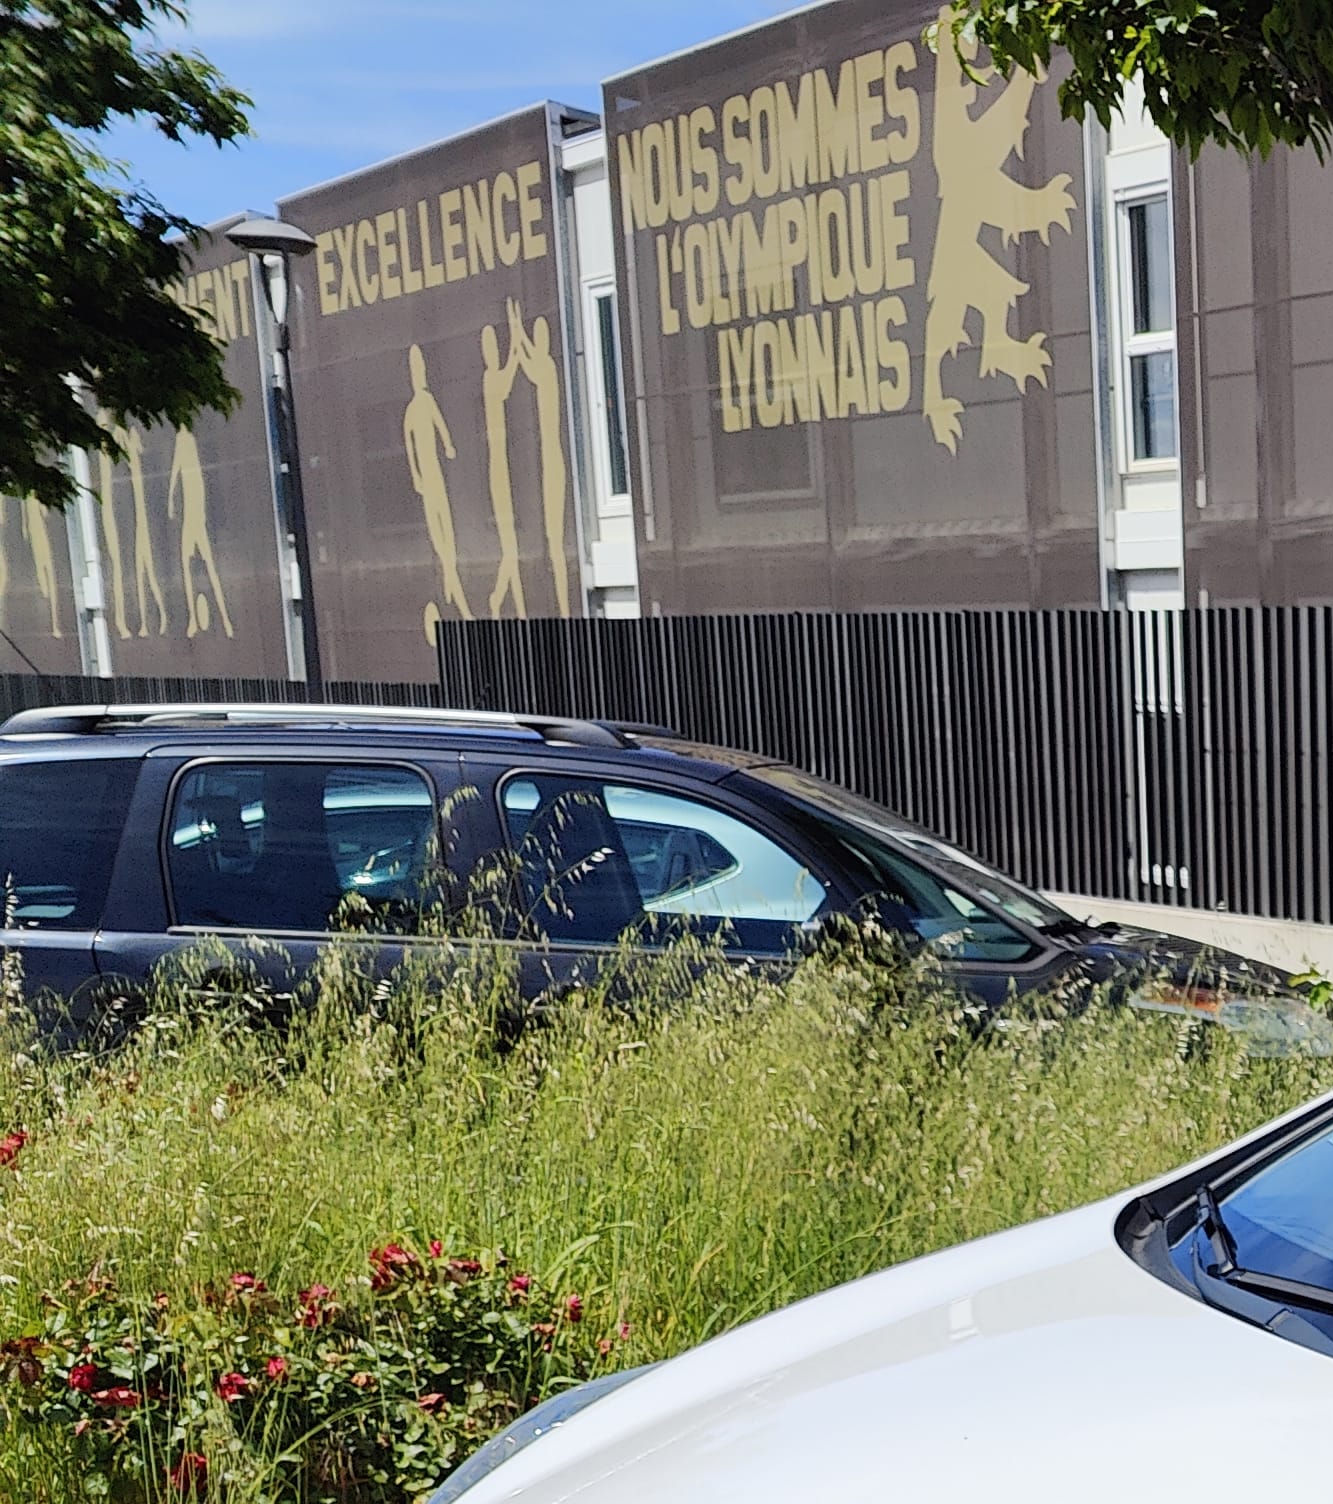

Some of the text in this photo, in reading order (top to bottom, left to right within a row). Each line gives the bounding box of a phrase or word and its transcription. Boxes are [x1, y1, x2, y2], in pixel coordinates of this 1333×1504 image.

[617, 41, 920, 233] NOUS SOMMES
[316, 162, 547, 316] EXCELLENCE
[656, 170, 915, 336] L'OLYMPIQUE
[717, 296, 911, 433] LYONNAIS
